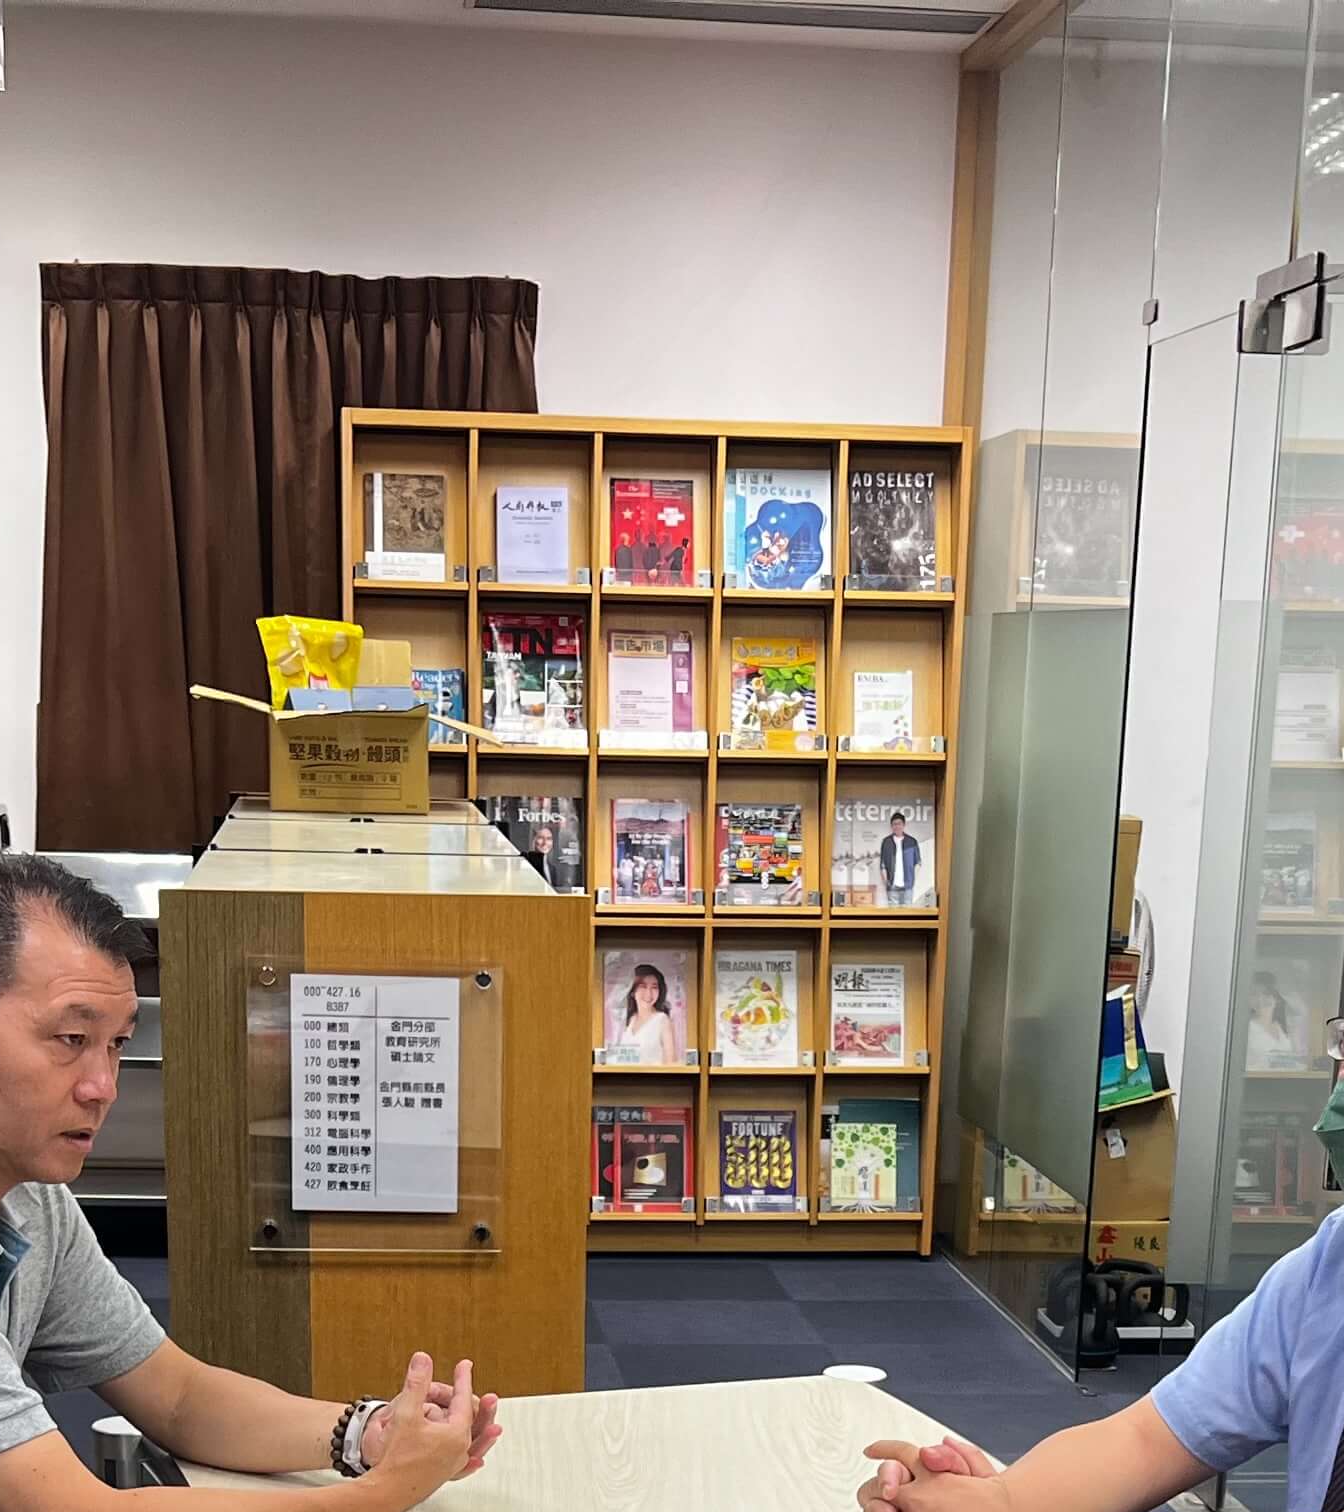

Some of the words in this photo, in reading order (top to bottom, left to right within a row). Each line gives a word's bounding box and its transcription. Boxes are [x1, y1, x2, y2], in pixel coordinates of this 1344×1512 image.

[852, 472, 873, 488] AD
[876, 472, 935, 488] SELECT
[518, 807, 567, 824] Forbes
[765, 961, 792, 973] TIMES
[304, 1021, 321, 1031] 000
[391, 1021, 436, 1033] 金門分部
[304, 1038, 321, 1049] 100
[385, 1036, 441, 1048] 教育研究所
[304, 1056, 321, 1067] 170
[326, 1058, 361, 1069] 心理學
[390, 1051, 436, 1064] 碩士論文
[304, 1074, 321, 1085] 190
[326, 1075, 361, 1087] 倫理學
[304, 1092, 321, 1103] 200
[326, 1093, 361, 1105] 宗教學
[304, 1110, 321, 1120] 300
[304, 1127, 321, 1138] 312
[326, 1128, 372, 1140] 電腦科學
[731, 1121, 784, 1136] FORTUNE
[304, 1145, 321, 1155] 400
[326, 1145, 372, 1157] 應用科學
[304, 1162, 321, 1173] 420
[326, 1163, 372, 1175] 家政手作
[304, 1179, 321, 1190] 427
[326, 1180, 371, 1192] 飲食烹飪
